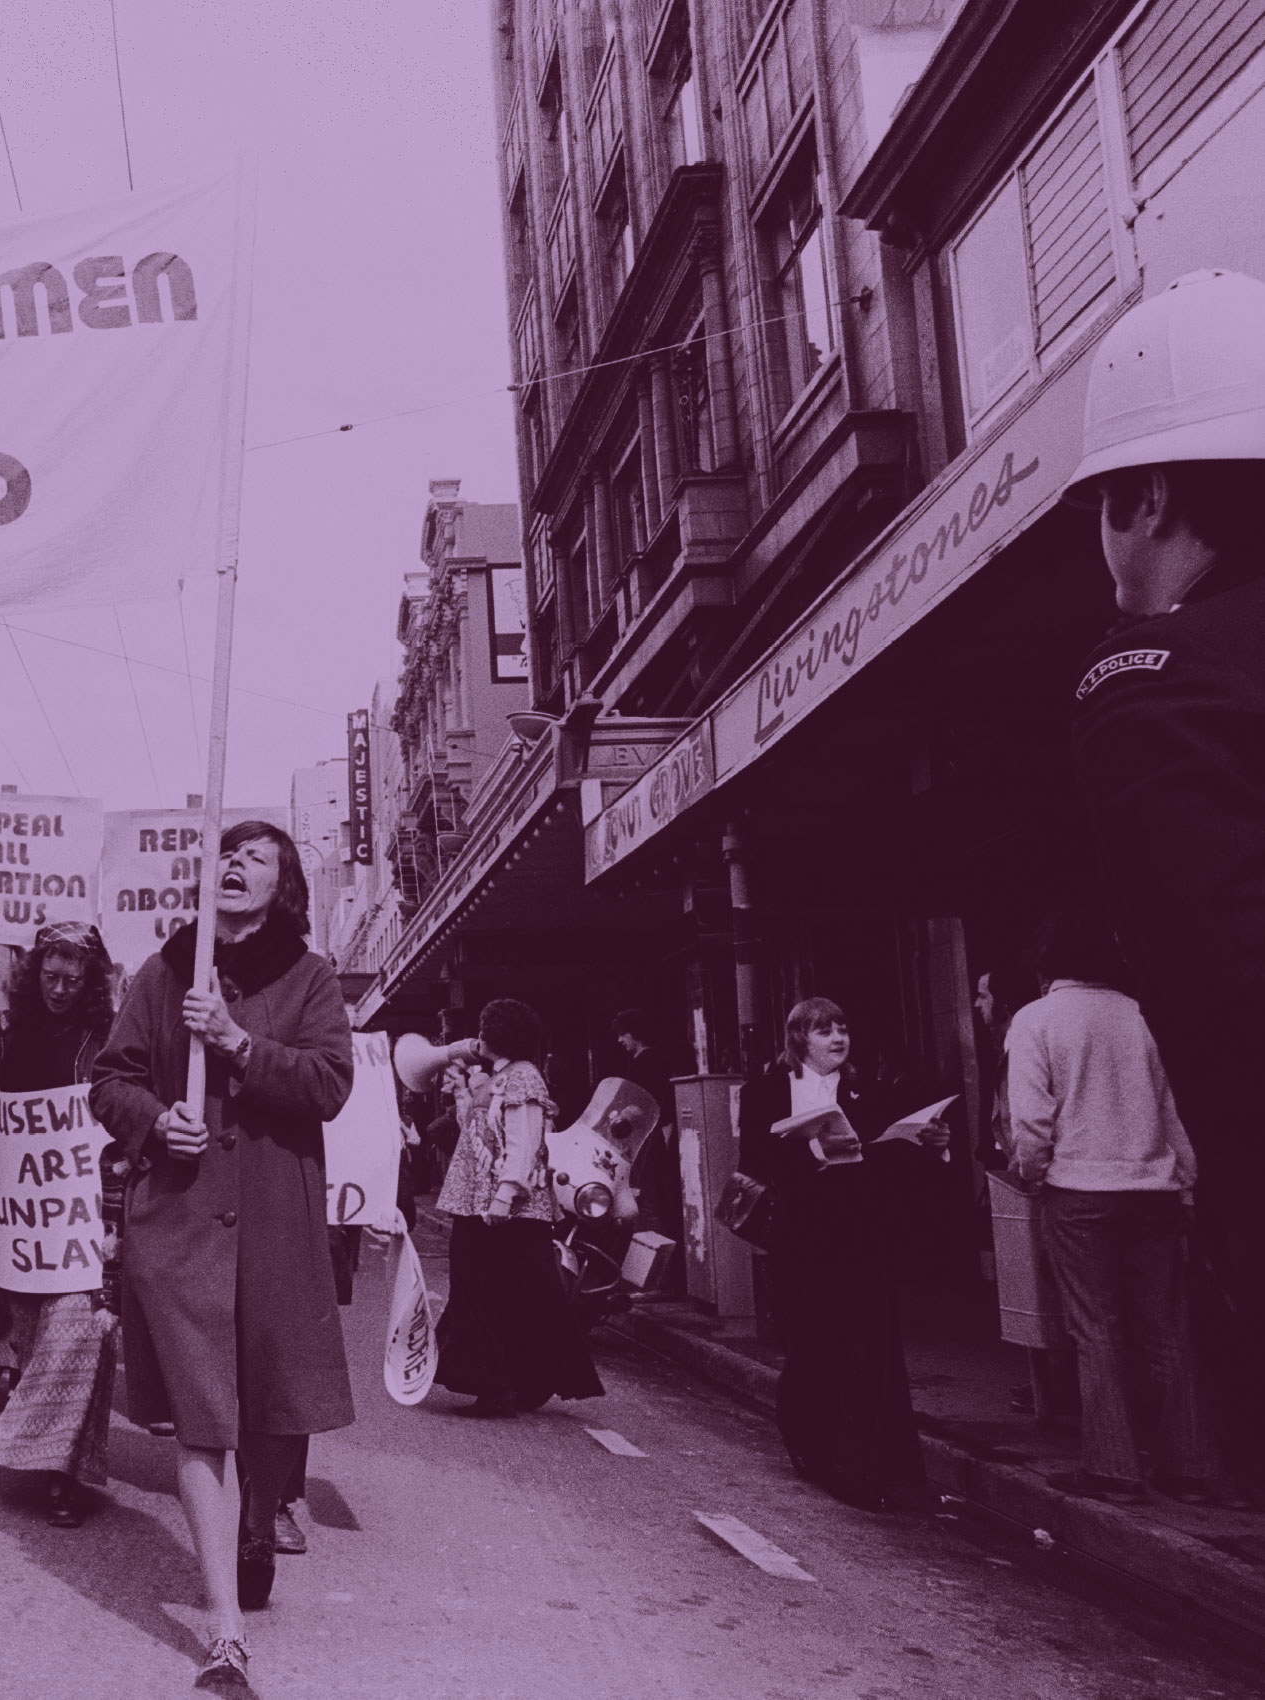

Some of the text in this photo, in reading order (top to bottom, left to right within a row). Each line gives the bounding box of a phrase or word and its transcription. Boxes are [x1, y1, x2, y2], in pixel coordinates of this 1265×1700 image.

[754, 451, 1040, 743] Livingstones
[1099, 653, 1158, 675] POLICE
[351, 713, 368, 858] MAJESTIC
[18, 1143, 93, 1187] ARE
